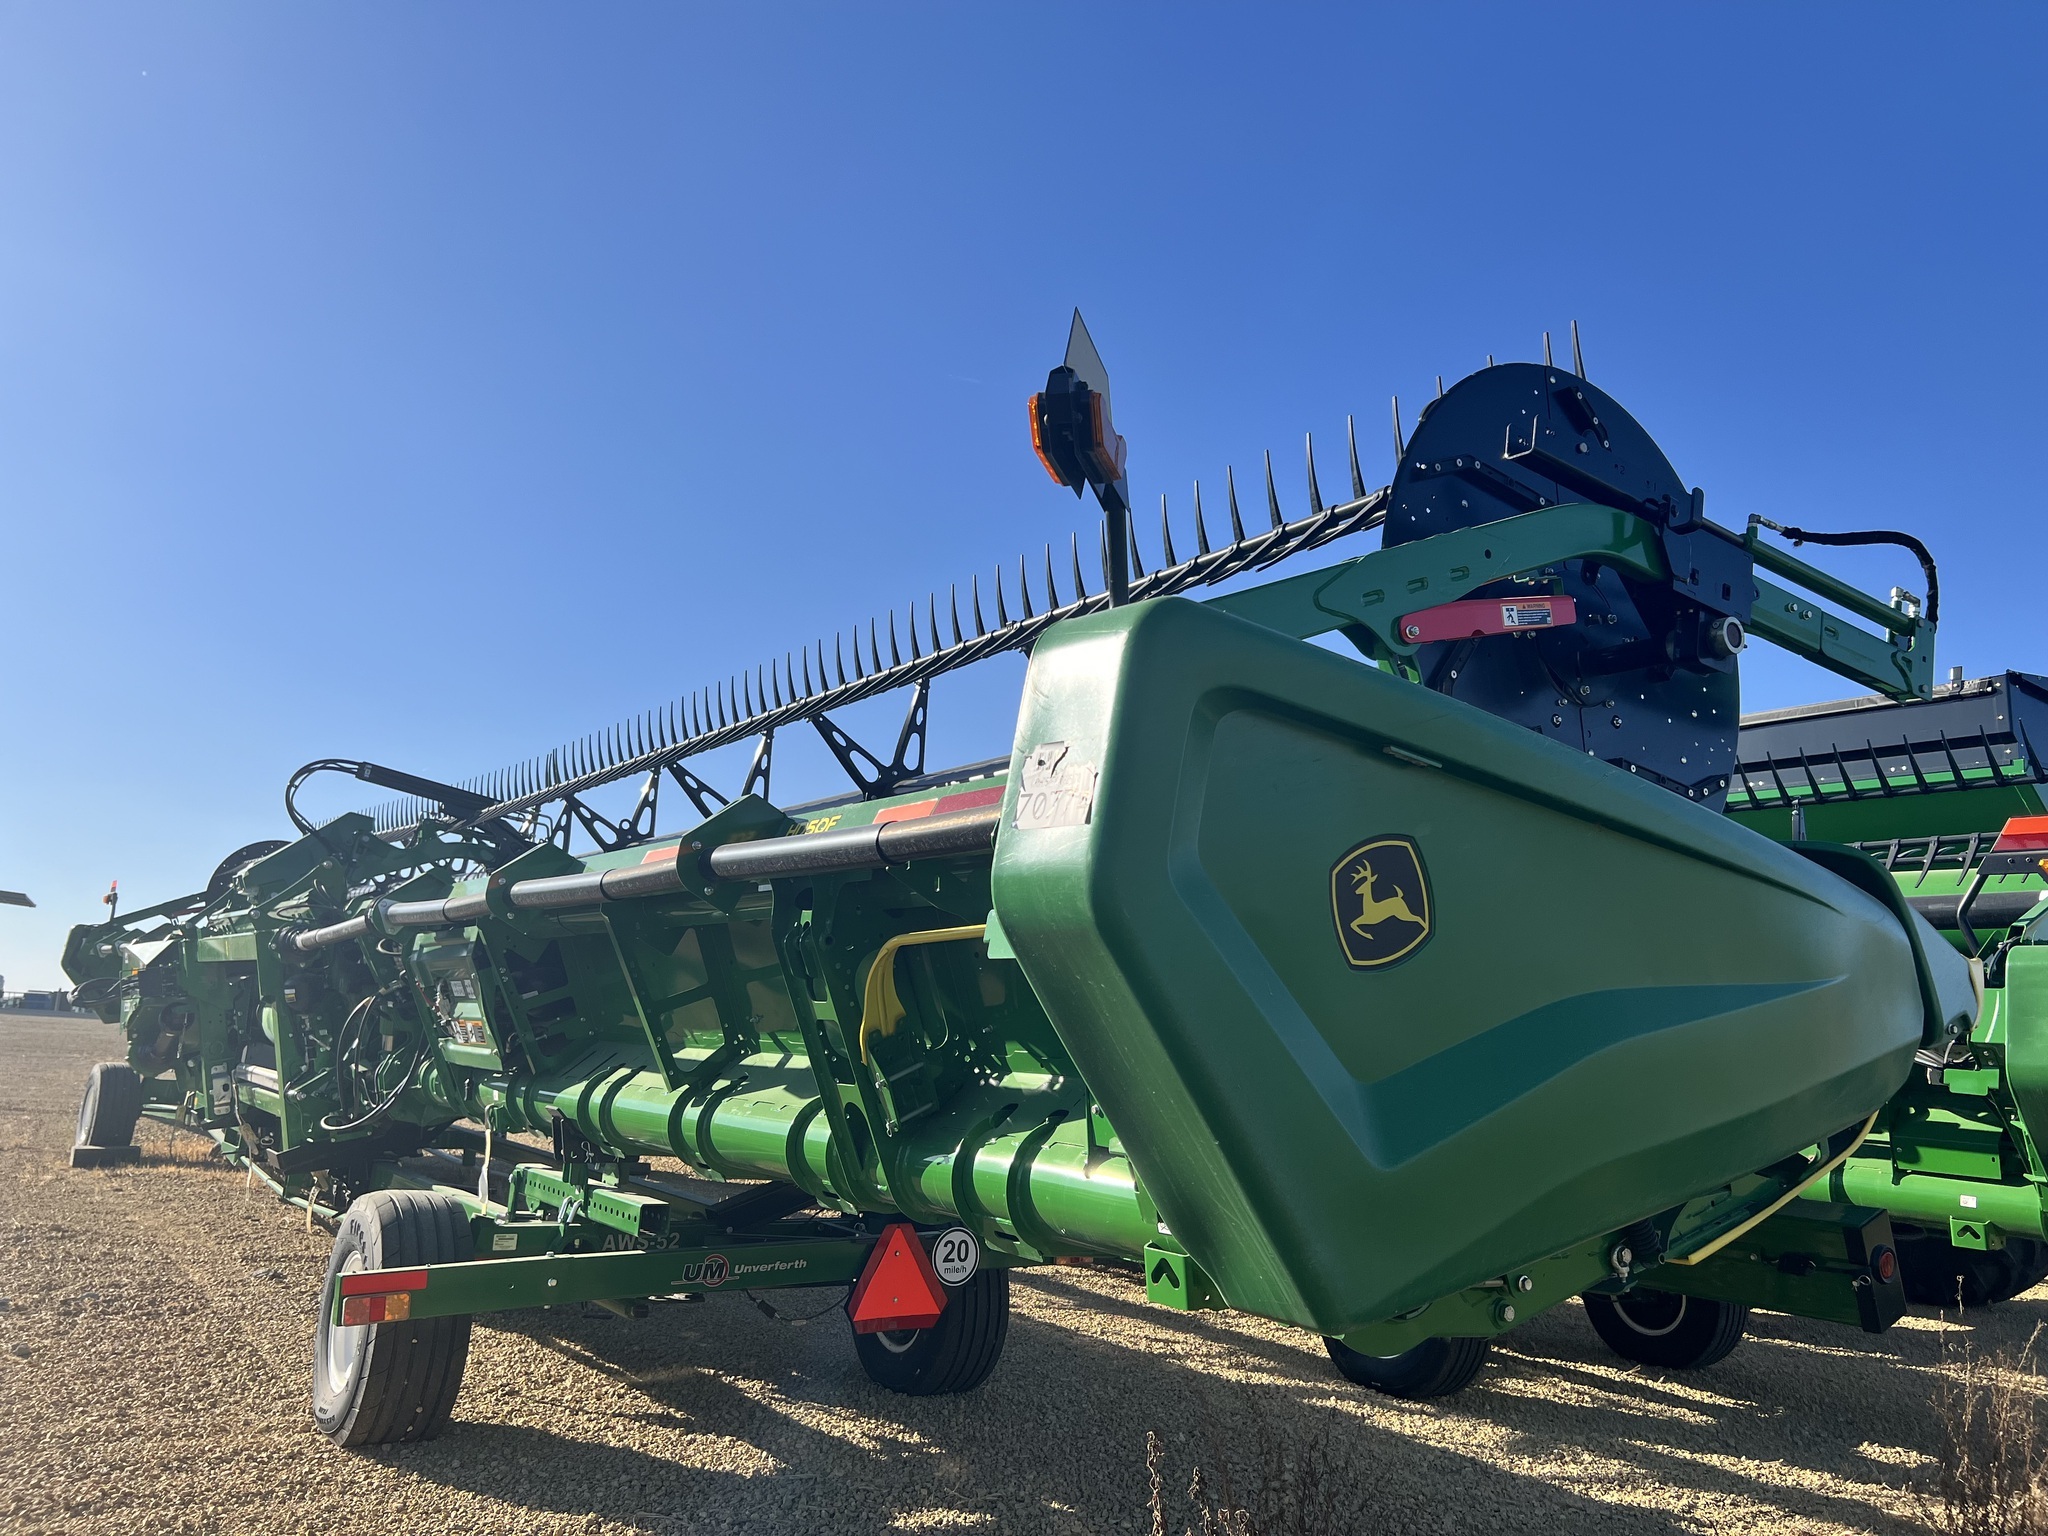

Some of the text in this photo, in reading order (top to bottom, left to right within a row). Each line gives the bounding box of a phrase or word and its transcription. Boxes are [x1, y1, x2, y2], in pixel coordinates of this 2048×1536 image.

[601, 1232, 680, 1251] AWS-52
[942, 1239, 970, 1263] 20
[682, 1259, 807, 1283] UM Unverferth
[943, 1266, 967, 1274] mile/h
